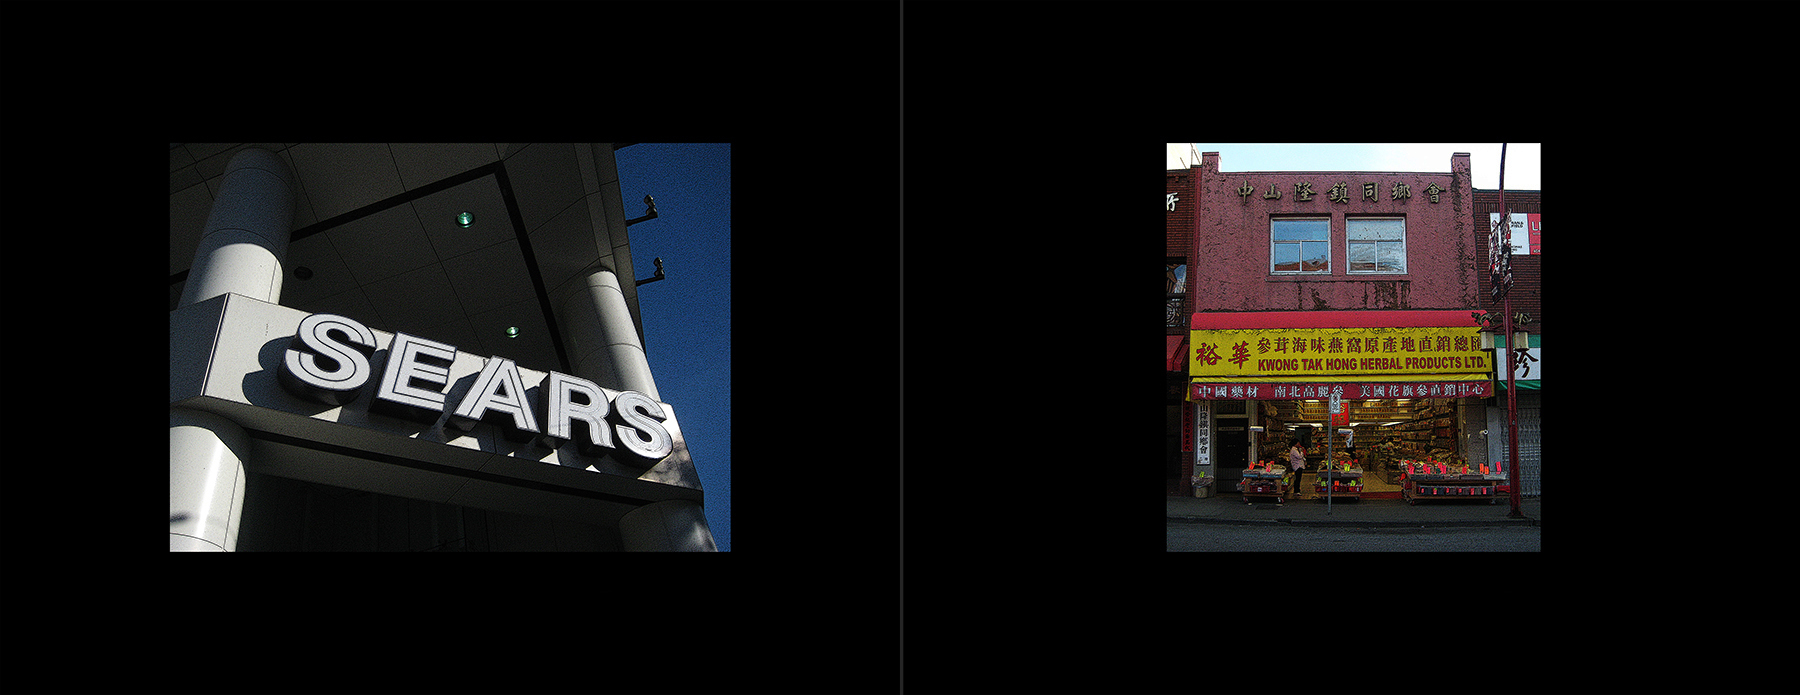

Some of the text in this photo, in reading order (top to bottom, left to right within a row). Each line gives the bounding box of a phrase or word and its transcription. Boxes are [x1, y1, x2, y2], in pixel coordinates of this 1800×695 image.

[282, 313, 674, 462] SEARS
[1258, 356, 1487, 371] KWONG TAK HONG HERBAL PRODUCTS LTD.
